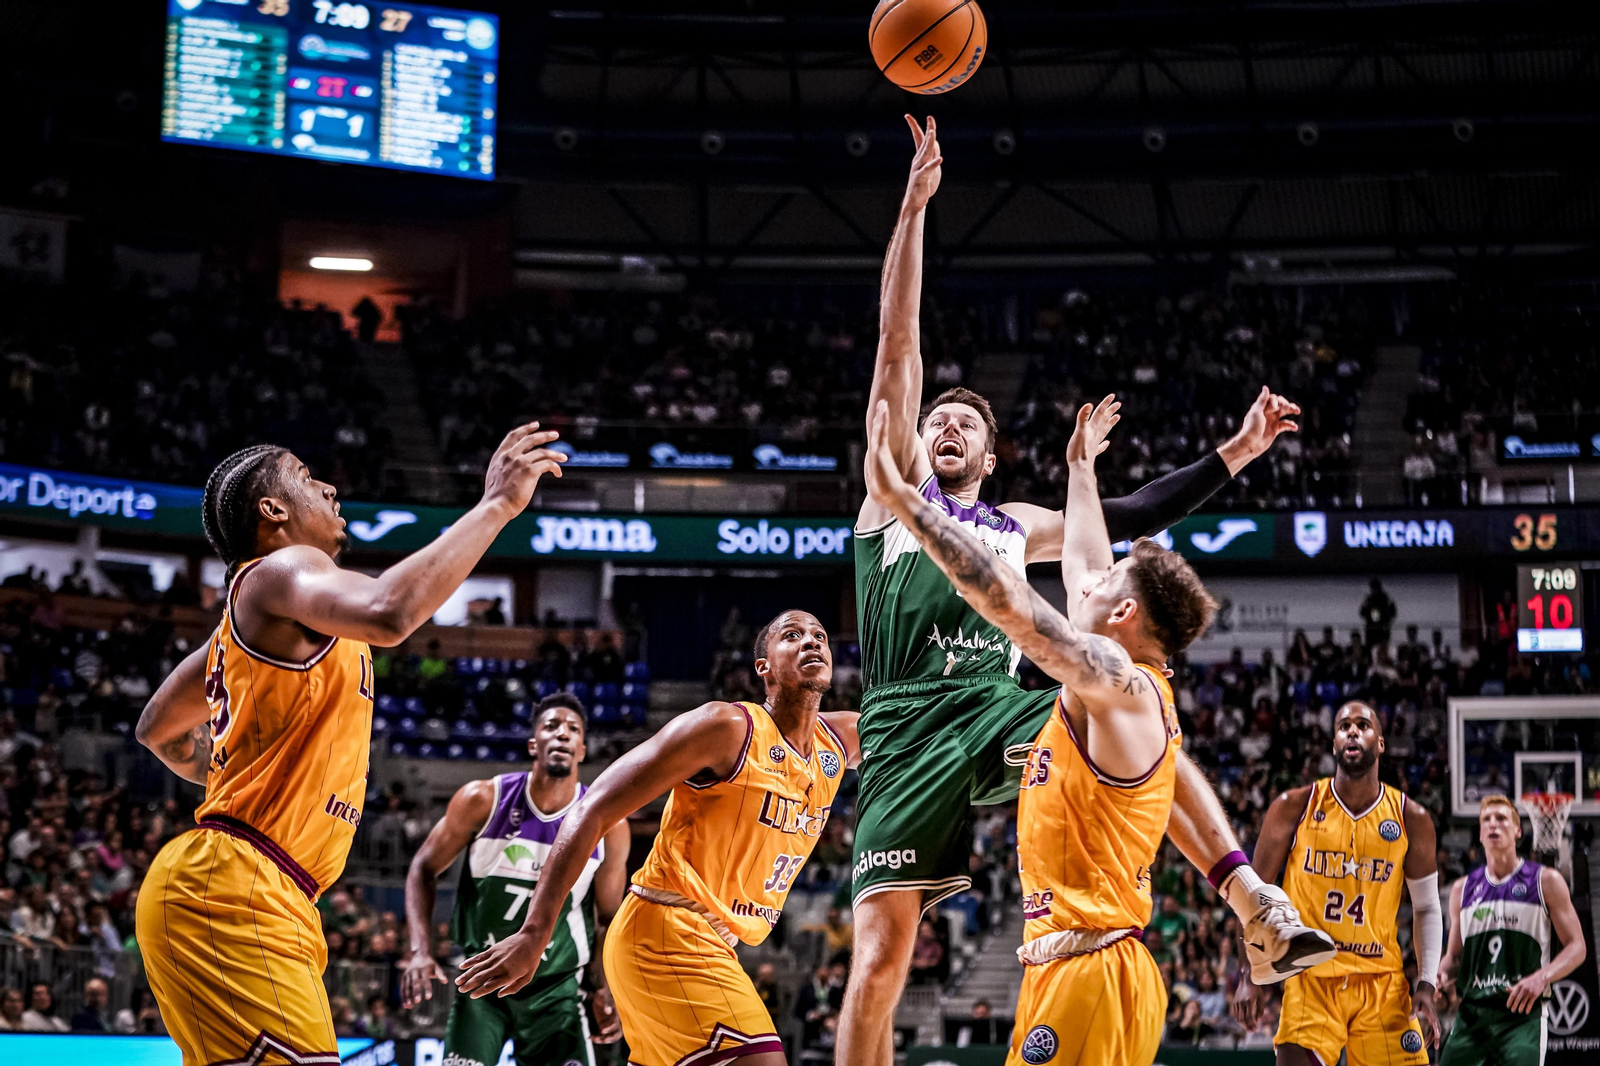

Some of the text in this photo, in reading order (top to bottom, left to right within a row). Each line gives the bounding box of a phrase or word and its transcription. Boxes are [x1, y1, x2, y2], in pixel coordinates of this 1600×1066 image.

[913, 44, 939, 66] FIBA
[717, 519, 850, 559] Solo por
[1343, 520, 1455, 548] UNICAJA
[1510, 513, 1558, 551] 35
[1531, 568, 1577, 590] 7:09
[1527, 594, 1573, 630] 10
[1324, 889, 1366, 926] 24
[1488, 935, 1503, 964] 9
